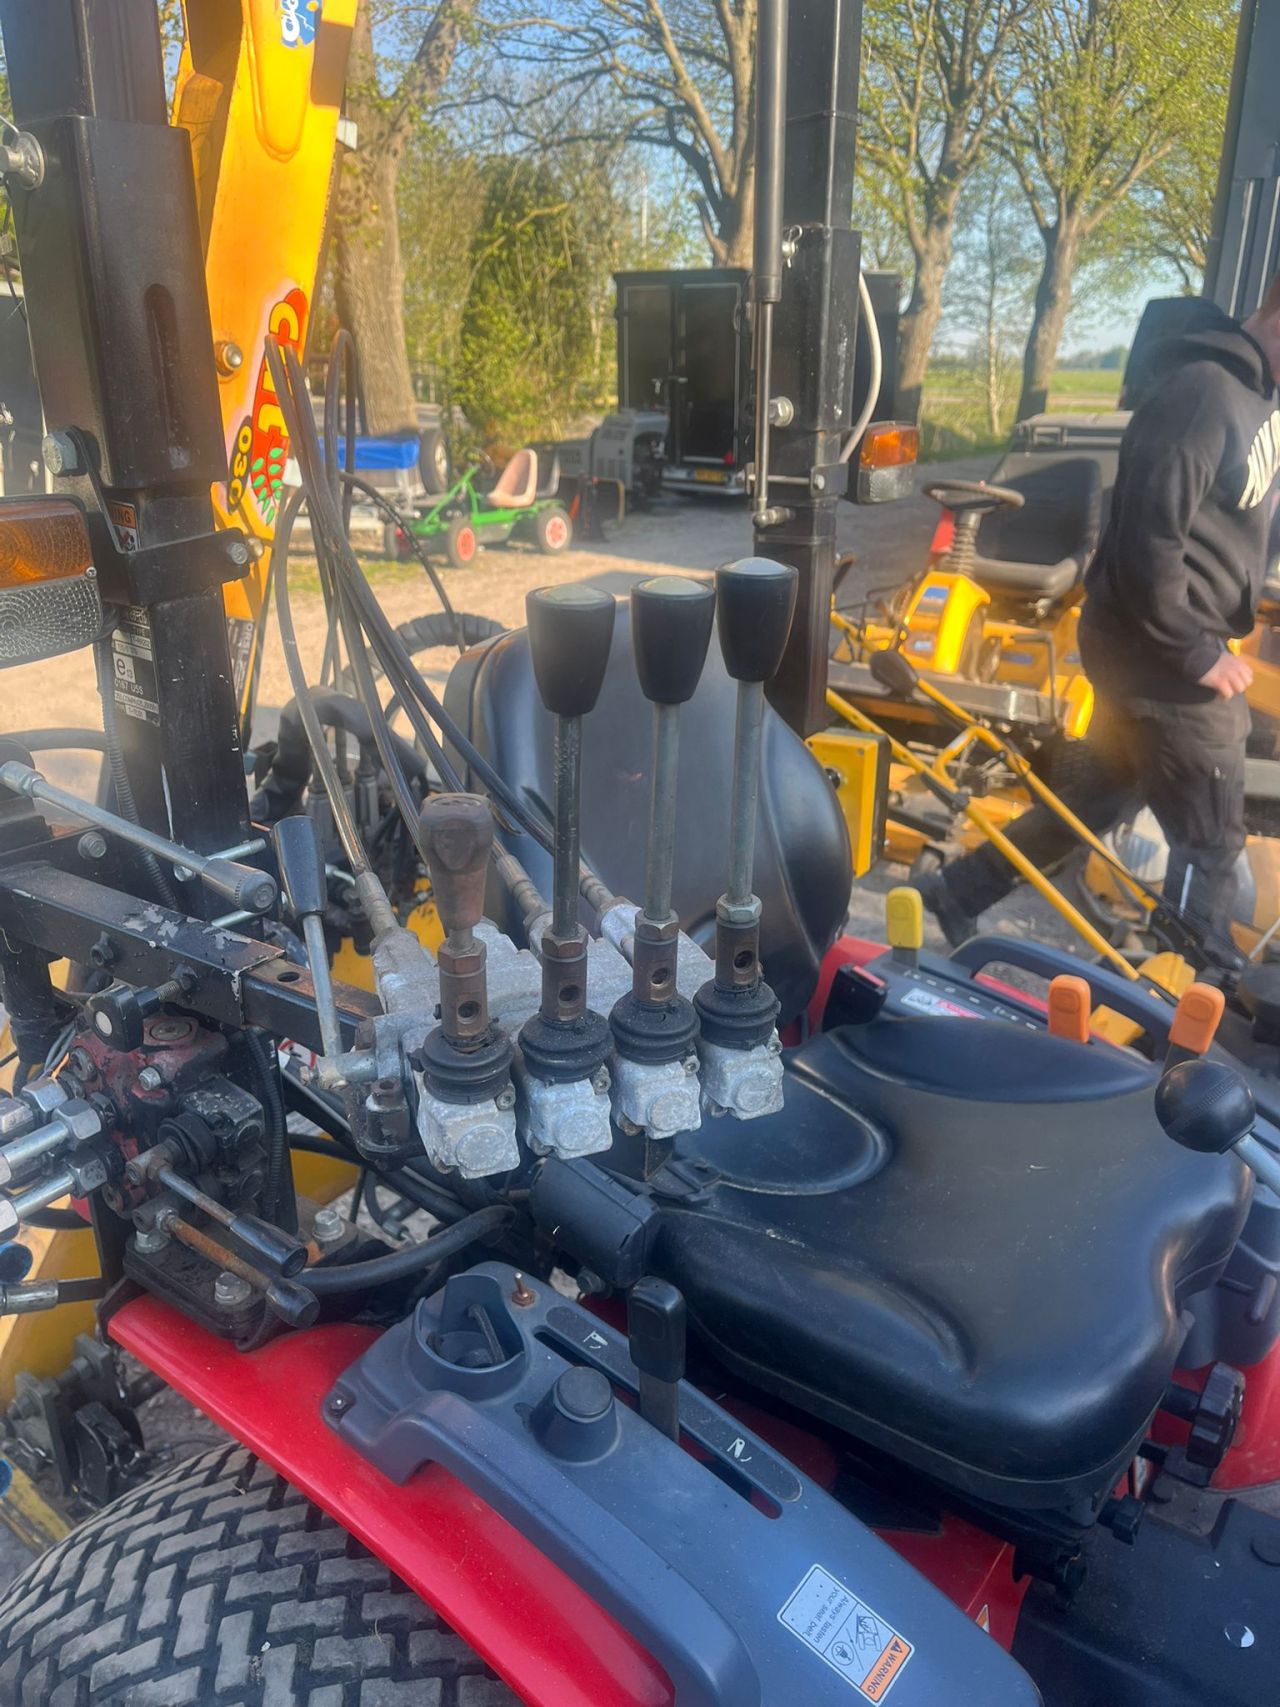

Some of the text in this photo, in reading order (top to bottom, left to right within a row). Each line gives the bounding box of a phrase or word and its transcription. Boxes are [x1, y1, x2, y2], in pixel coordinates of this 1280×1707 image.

[828, 1586, 840, 1605] your
[813, 1595, 850, 1644] Always fasten
[817, 1604, 829, 1622] seat
[867, 1653, 898, 1695] WARNING
